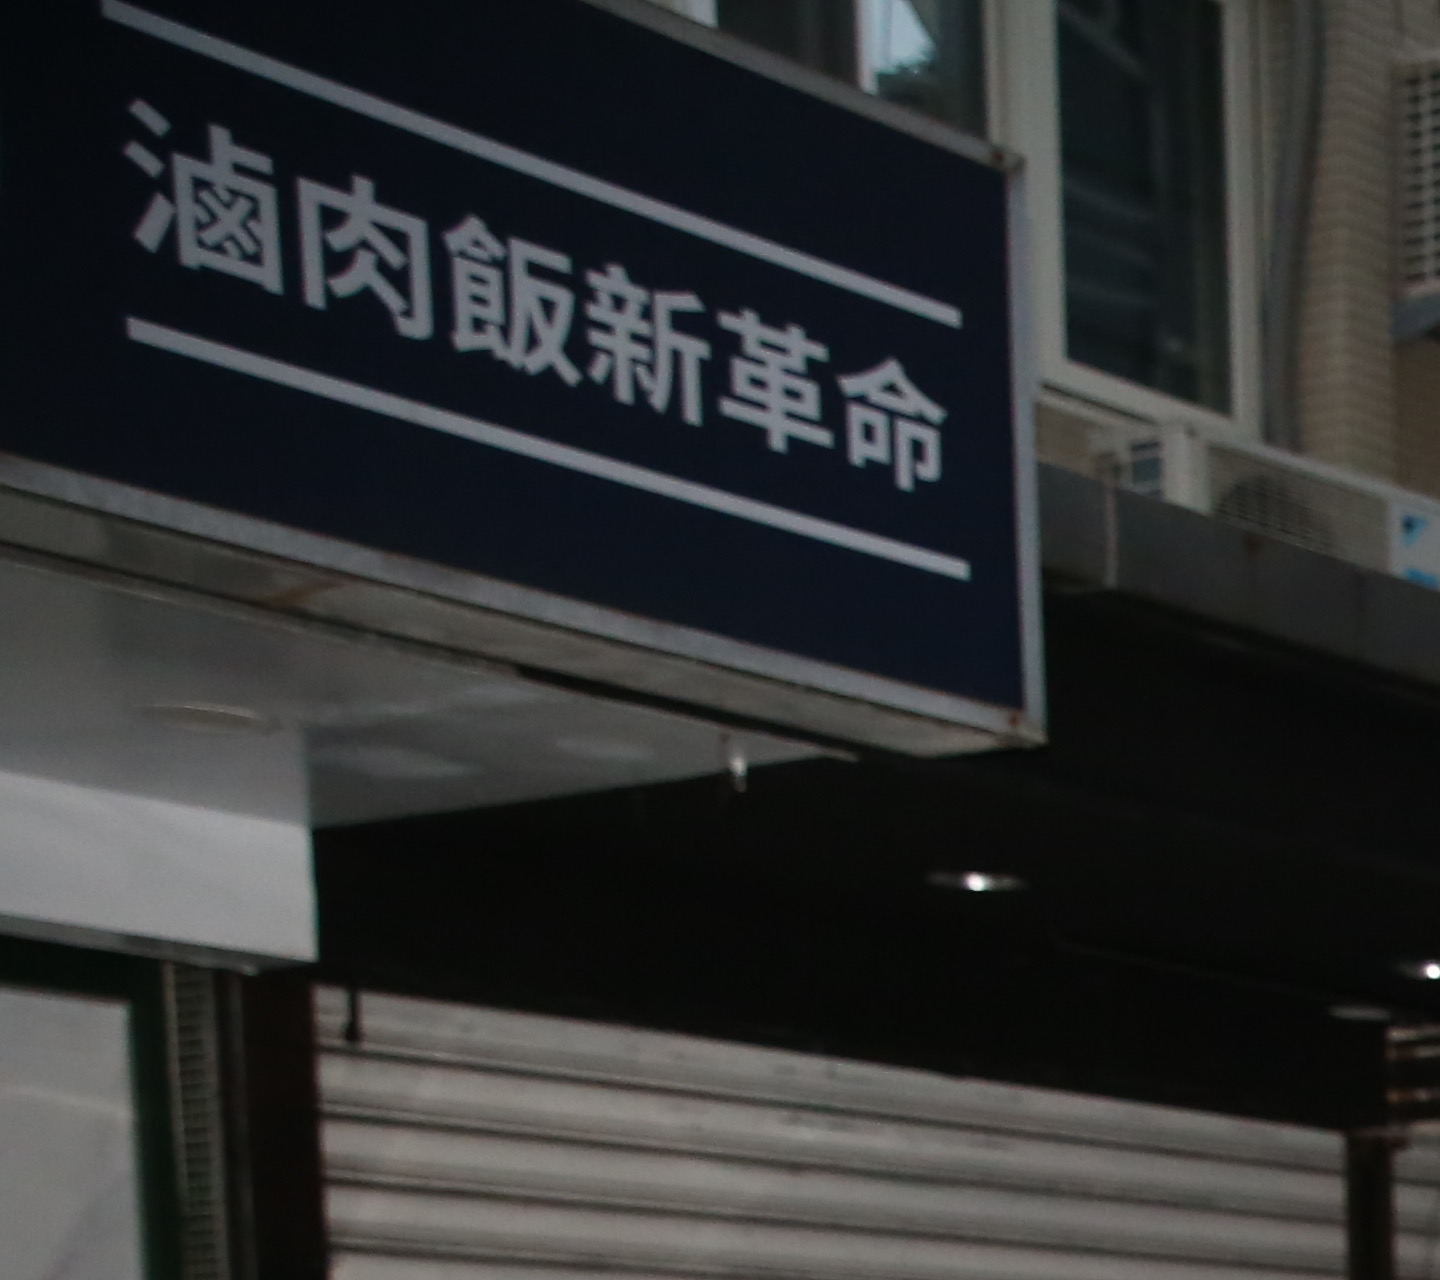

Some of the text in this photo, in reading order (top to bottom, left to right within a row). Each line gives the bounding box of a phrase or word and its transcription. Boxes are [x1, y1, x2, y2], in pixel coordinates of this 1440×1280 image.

[123, 98, 948, 492] 滷肉飯新革命
